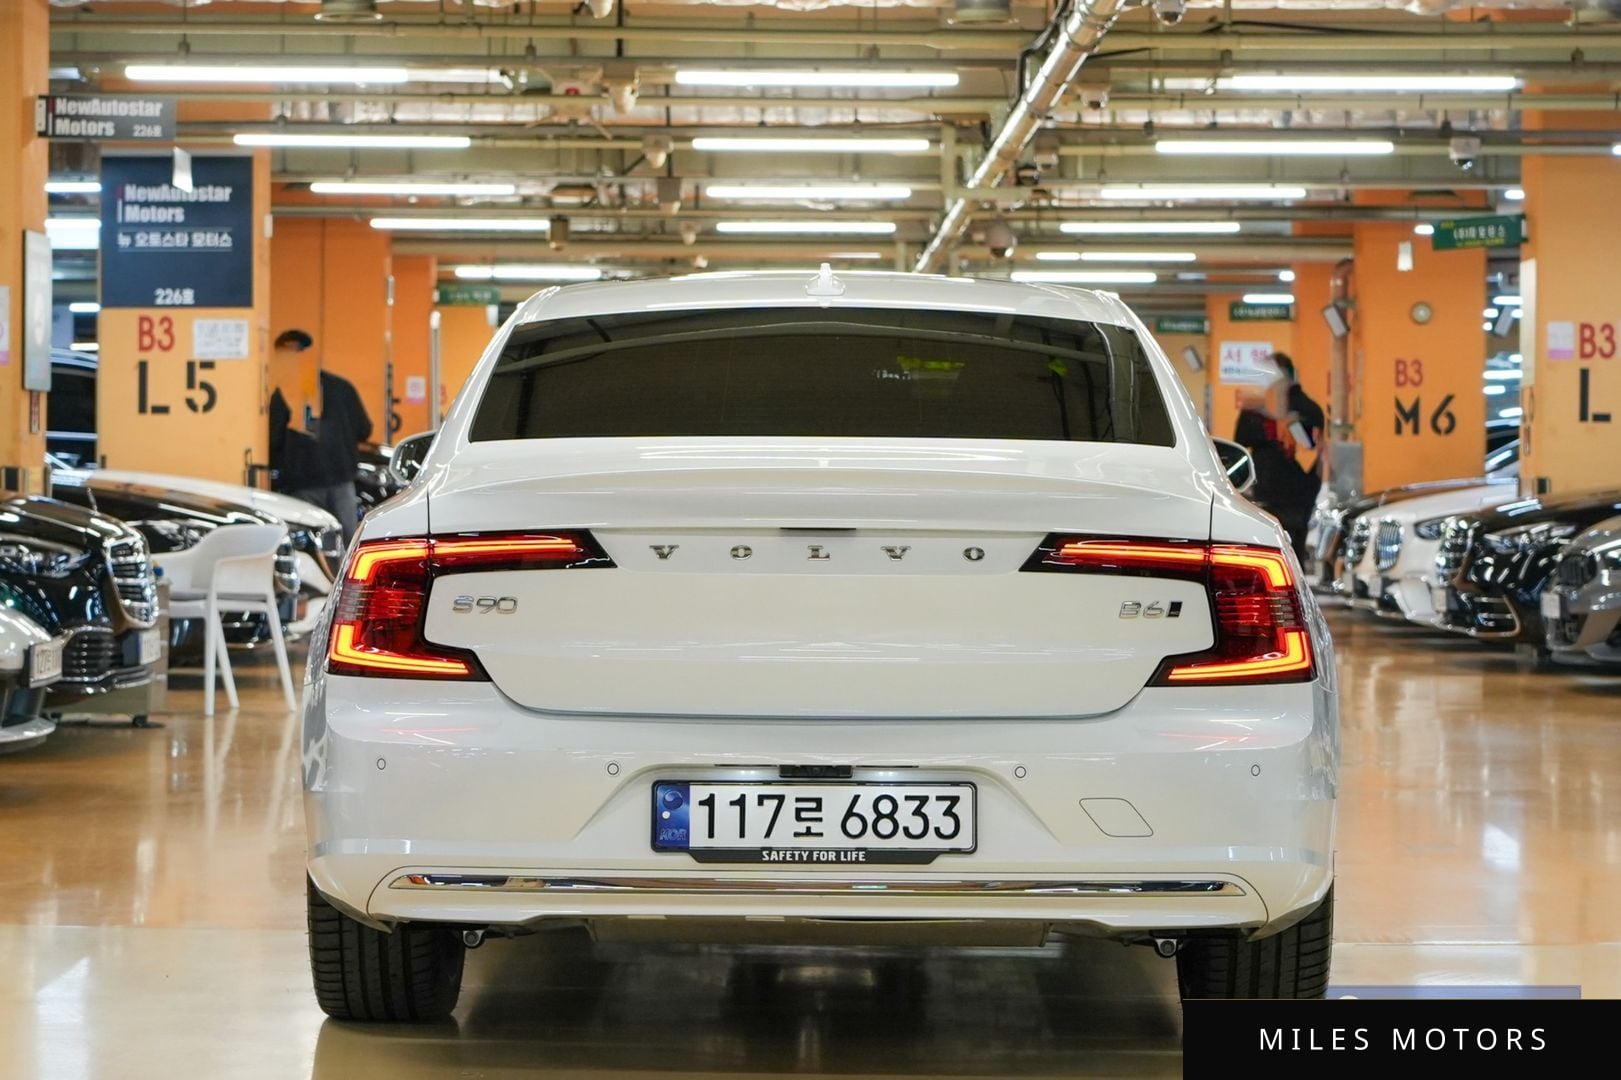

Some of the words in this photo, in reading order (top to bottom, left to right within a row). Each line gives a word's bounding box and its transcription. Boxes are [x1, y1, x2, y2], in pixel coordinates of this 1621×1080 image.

[55, 98, 162, 116] NewAutostar
[55, 118, 115, 136] Motors
[124, 184, 232, 202] NewAutostar
[124, 204, 184, 222] Motors
[135, 232, 189, 247] 오토스타
[192, 232, 232, 247] 모터스
[154, 288, 194, 305] 226호
[138, 316, 174, 352] B3
[1579, 323, 1616, 359] B3
[1395, 359, 1424, 387] B3
[1579, 368, 1612, 422] L
[649, 544, 986, 561] VOLVO
[452, 595, 518, 615] S90
[1119, 601, 1165, 619] B6
[698, 793, 824, 839] 117로
[840, 794, 961, 840] 6833
[761, 850, 810, 862] SAFETY
[812, 850, 837, 862] FOR
[840, 850, 867, 862] LIFE
